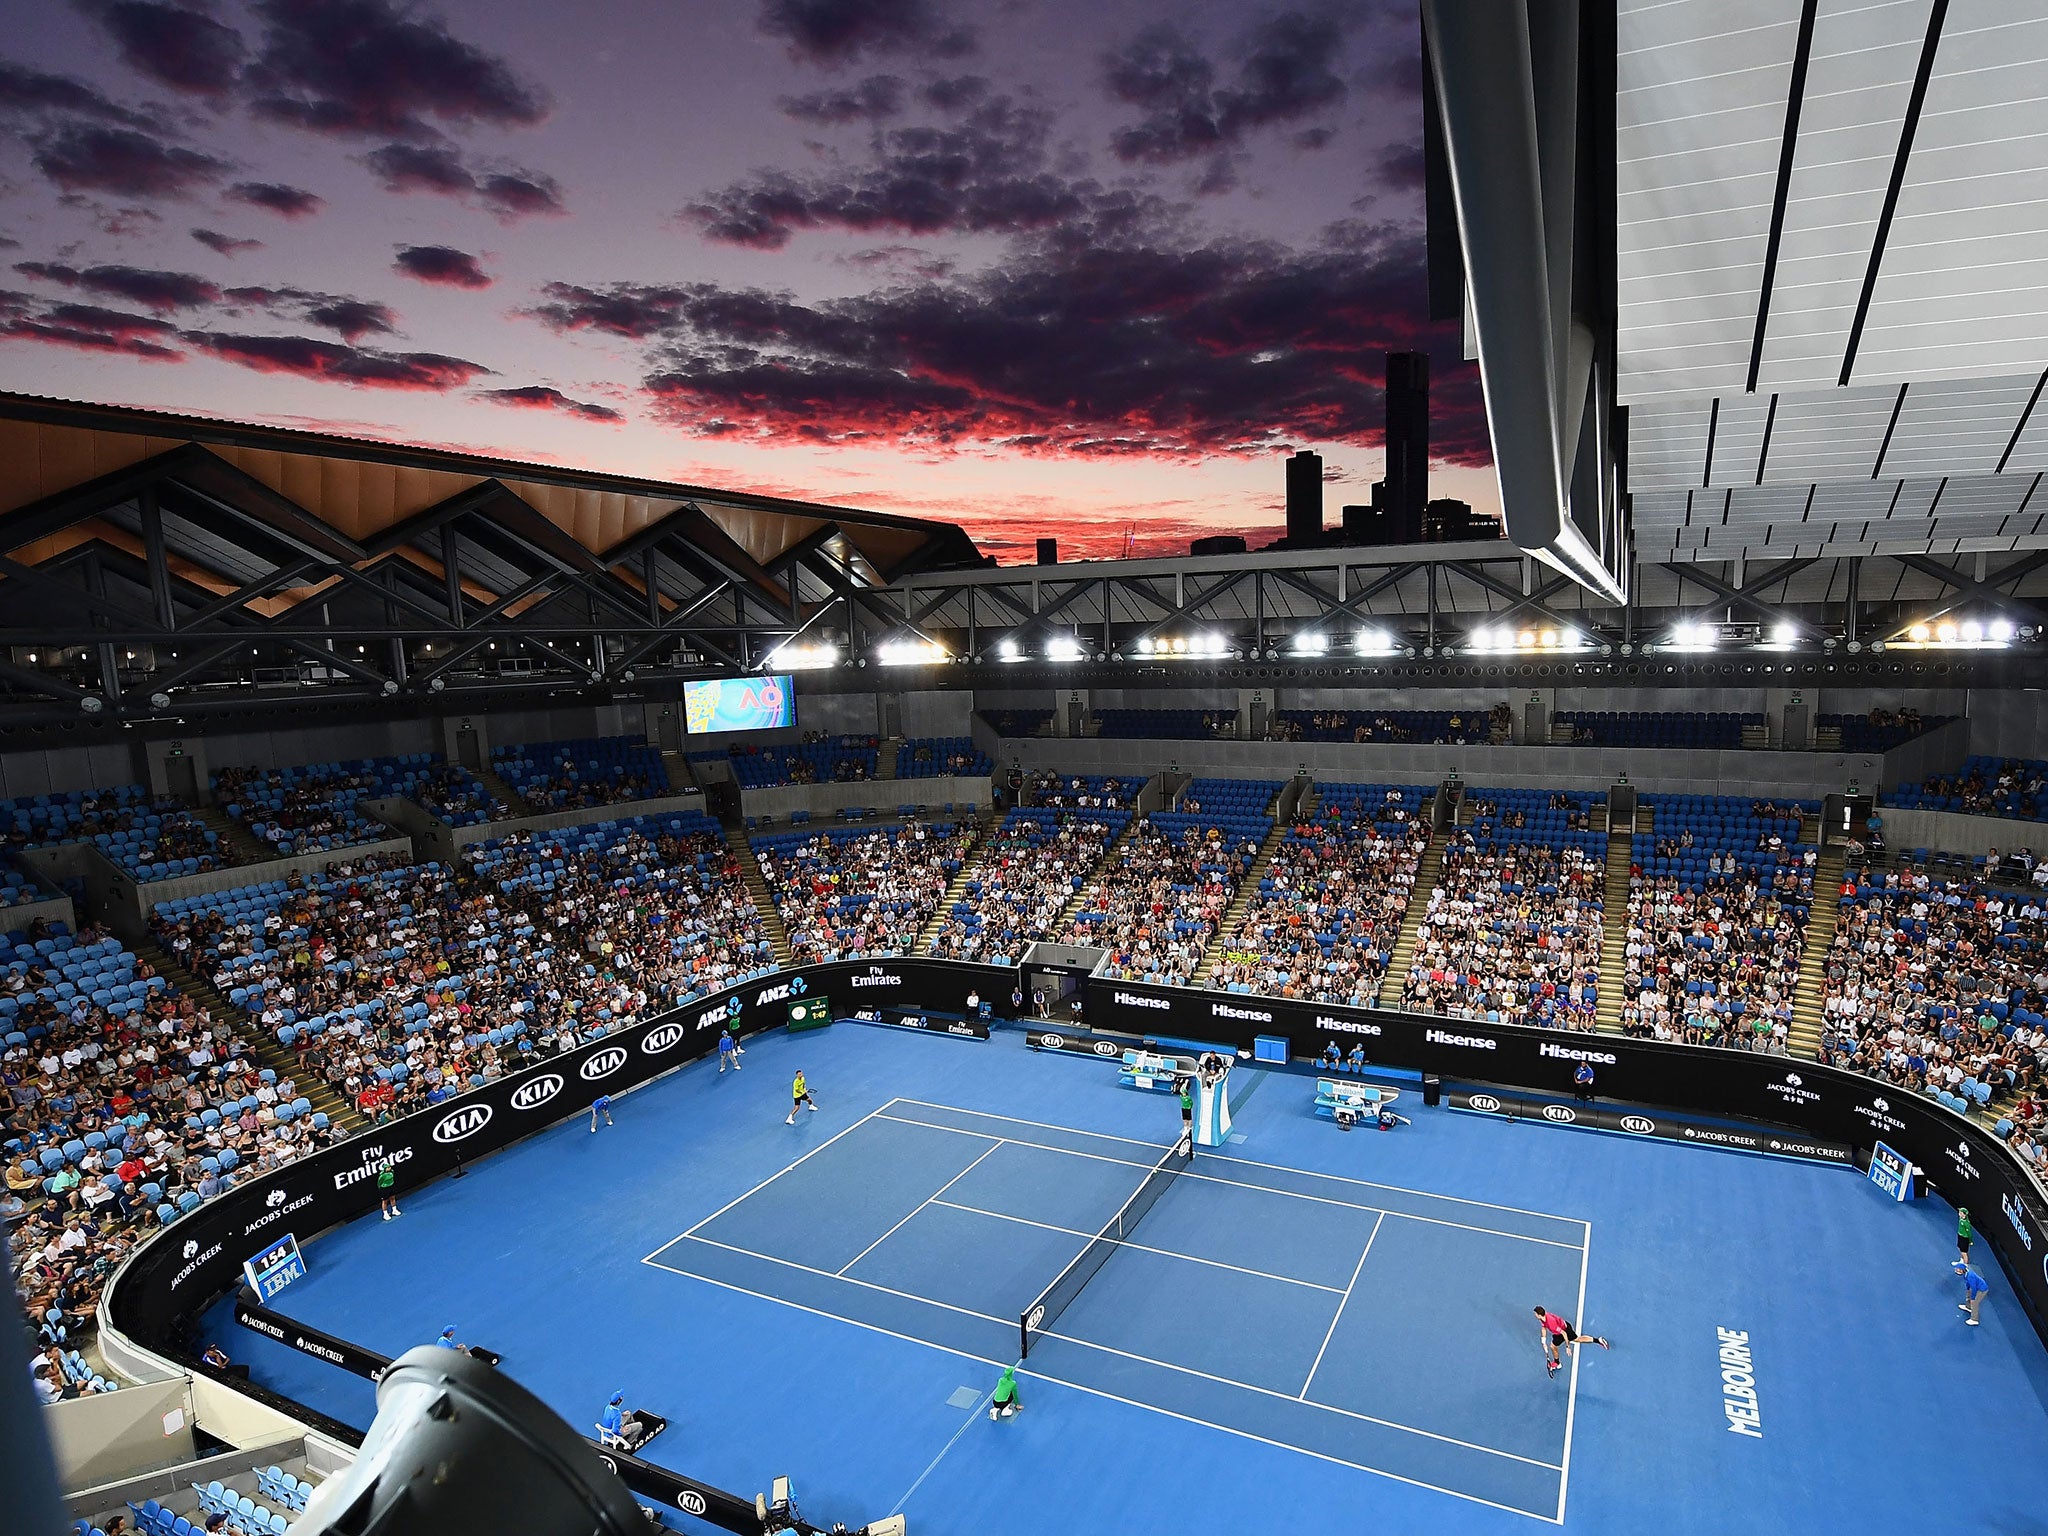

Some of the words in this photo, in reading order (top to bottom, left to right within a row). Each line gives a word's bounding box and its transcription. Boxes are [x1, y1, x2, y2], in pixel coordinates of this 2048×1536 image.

[740, 685, 782, 709] AO
[50, 852, 57, 860] 7
[851, 974, 902, 987] Emirates
[870, 966, 883, 976] Fly
[756, 984, 789, 1006] ANZ
[1114, 992, 1170, 1010] Hisense
[697, 1005, 727, 1030] ANZ
[855, 1010, 874, 1021] ANZ
[900, 1017, 919, 1027] ANZ
[1212, 1004, 1272, 1022] Hisense
[948, 1025, 974, 1036] Emirates
[1316, 1016, 1382, 1036] Hisense
[648, 1028, 676, 1050] KIA
[1426, 1029, 1497, 1050] Hisense
[587, 1052, 620, 1077] KIA
[1540, 1043, 1616, 1065] Hisense
[519, 1080, 556, 1106] KIA
[1766, 1083, 1795, 1094] JACOB'S
[1796, 1090, 1820, 1100] CREEK
[442, 1110, 483, 1138] KIA
[1854, 1106, 1882, 1119] JACOB'S
[1884, 1116, 1906, 1130] CREEK
[1696, 1130, 1728, 1142] JACOB'S
[1729, 1135, 1756, 1146] CREEK
[361, 1145, 383, 1161] Fly
[1782, 1142, 1816, 1154] JACOB'S
[1816, 1148, 1845, 1159] CREEK
[1882, 1151, 1899, 1170] 154
[334, 1146, 413, 1190] Emirates
[1965, 1162, 1980, 1179] CREEK
[1872, 1167, 1899, 1197] IBM
[244, 1209, 281, 1235] JACOB'S
[282, 1194, 314, 1214] CREEK
[2015, 1194, 2024, 1217] Fly
[2002, 1193, 2032, 1250] Emirates
[171, 1260, 196, 1290] JACOB'S
[196, 1242, 222, 1266] CREEK
[261, 1246, 286, 1268] 154
[264, 1262, 302, 1297] IBM
[248, 1317, 267, 1331] JACOB'S
[268, 1325, 284, 1338] CREEK
[304, 1342, 325, 1356] JACOB'S
[326, 1349, 344, 1363] CREEK
[1716, 1326, 1762, 1438] MELBOURNE
[645, 1432, 654, 1442] AO
[655, 1424, 664, 1433] AO
